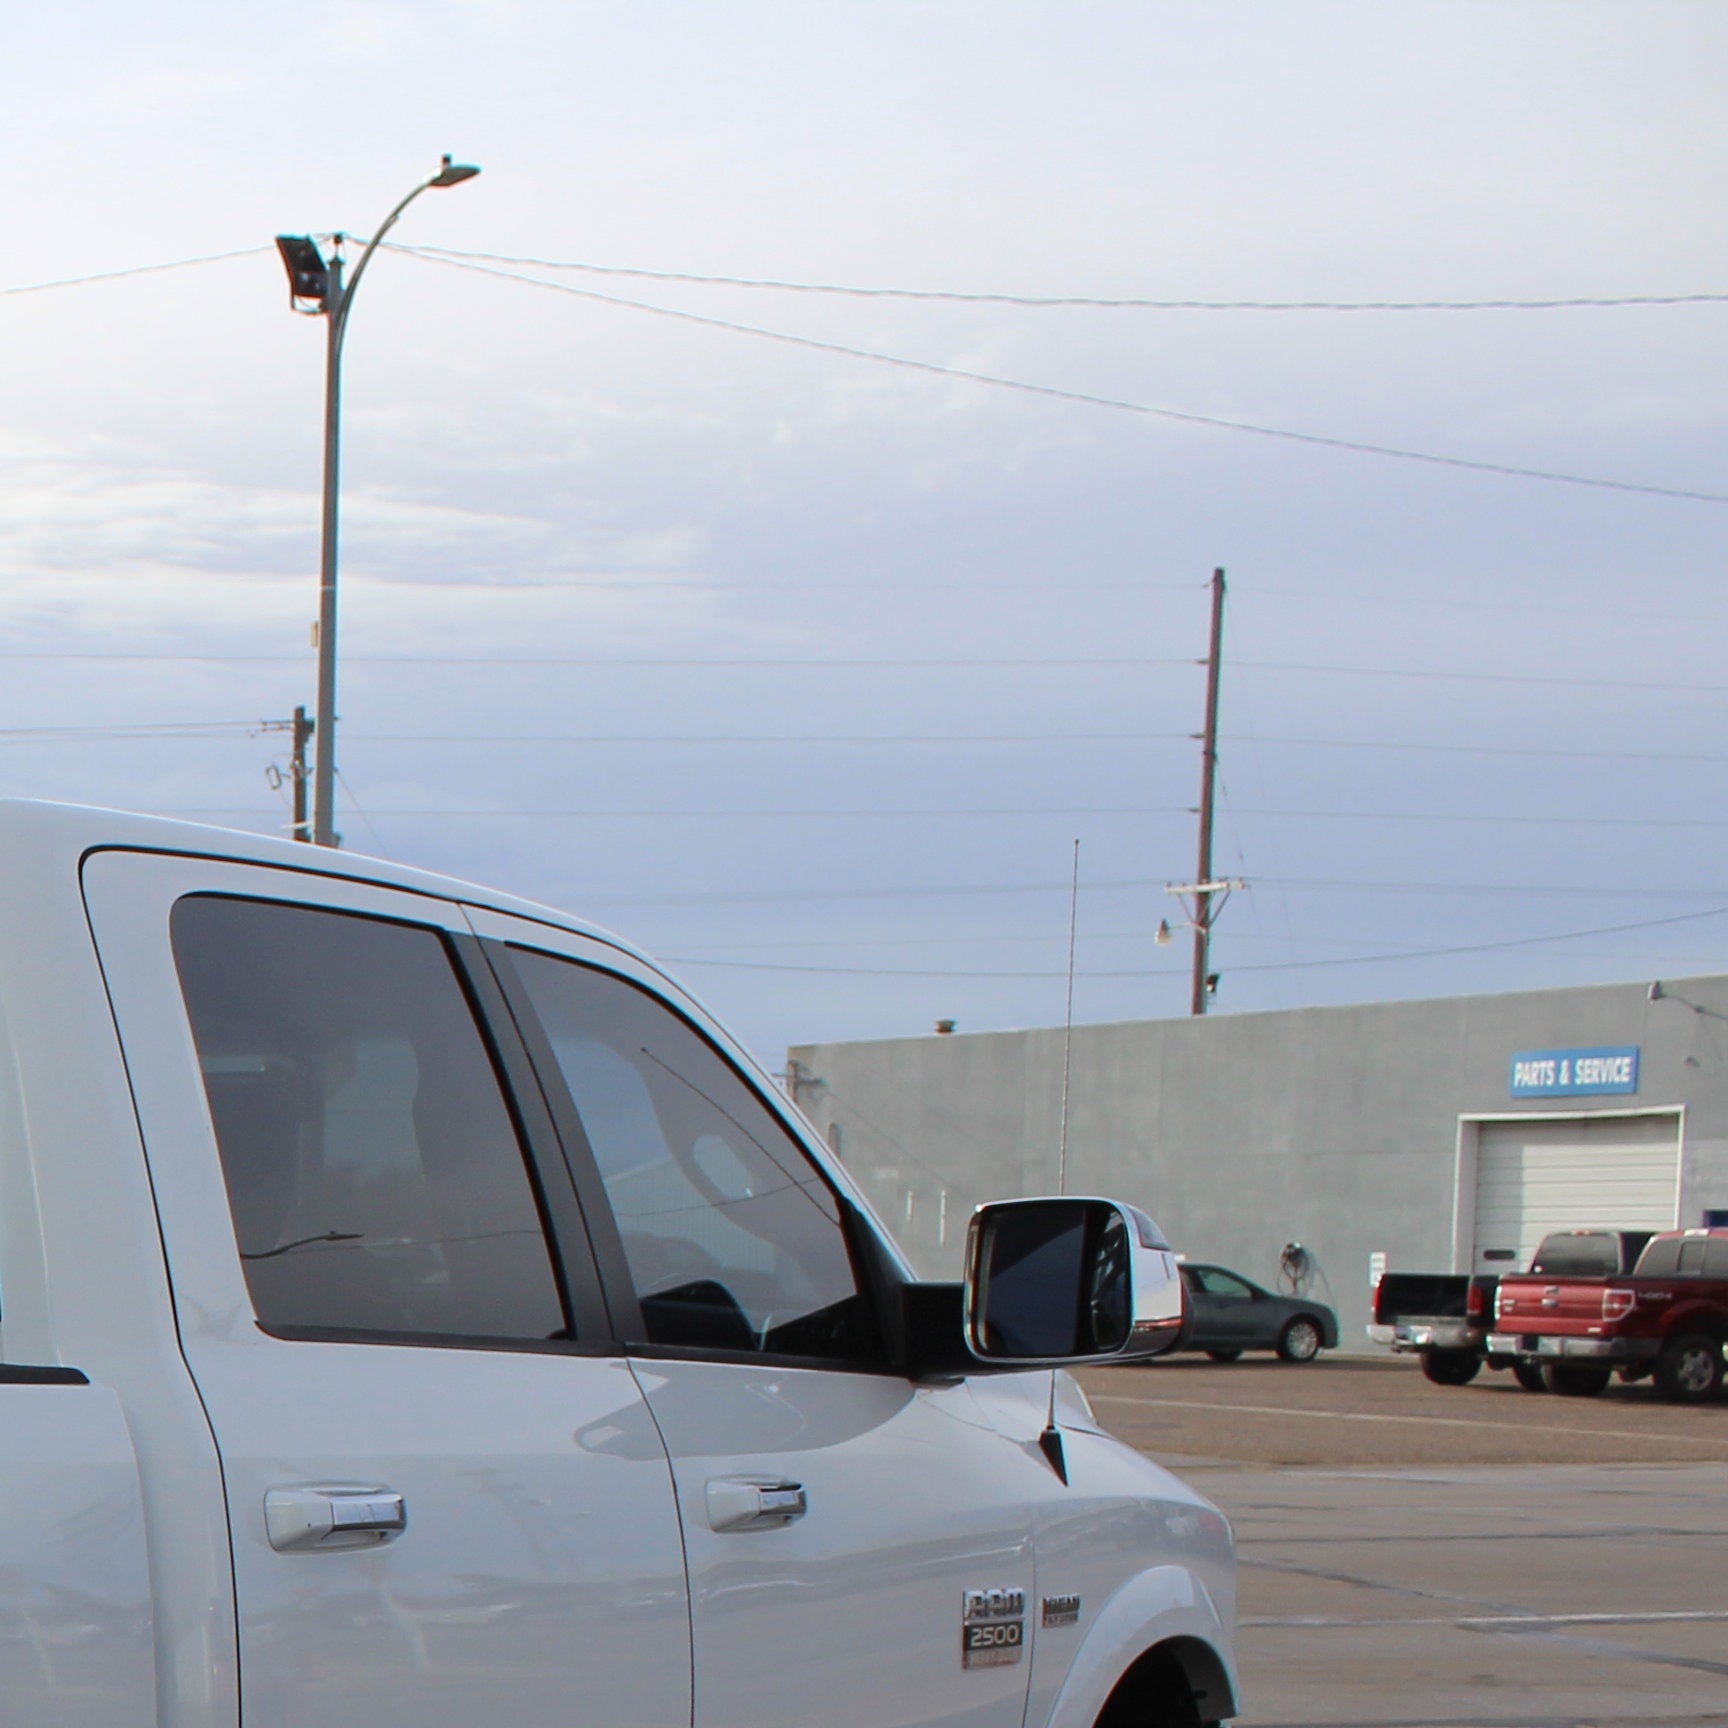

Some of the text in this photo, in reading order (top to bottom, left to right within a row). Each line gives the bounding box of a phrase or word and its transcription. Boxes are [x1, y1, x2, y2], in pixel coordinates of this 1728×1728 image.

[1514, 1056, 1633, 1087] PARTS & SERVICE
[970, 1624, 1020, 1648] 2500
